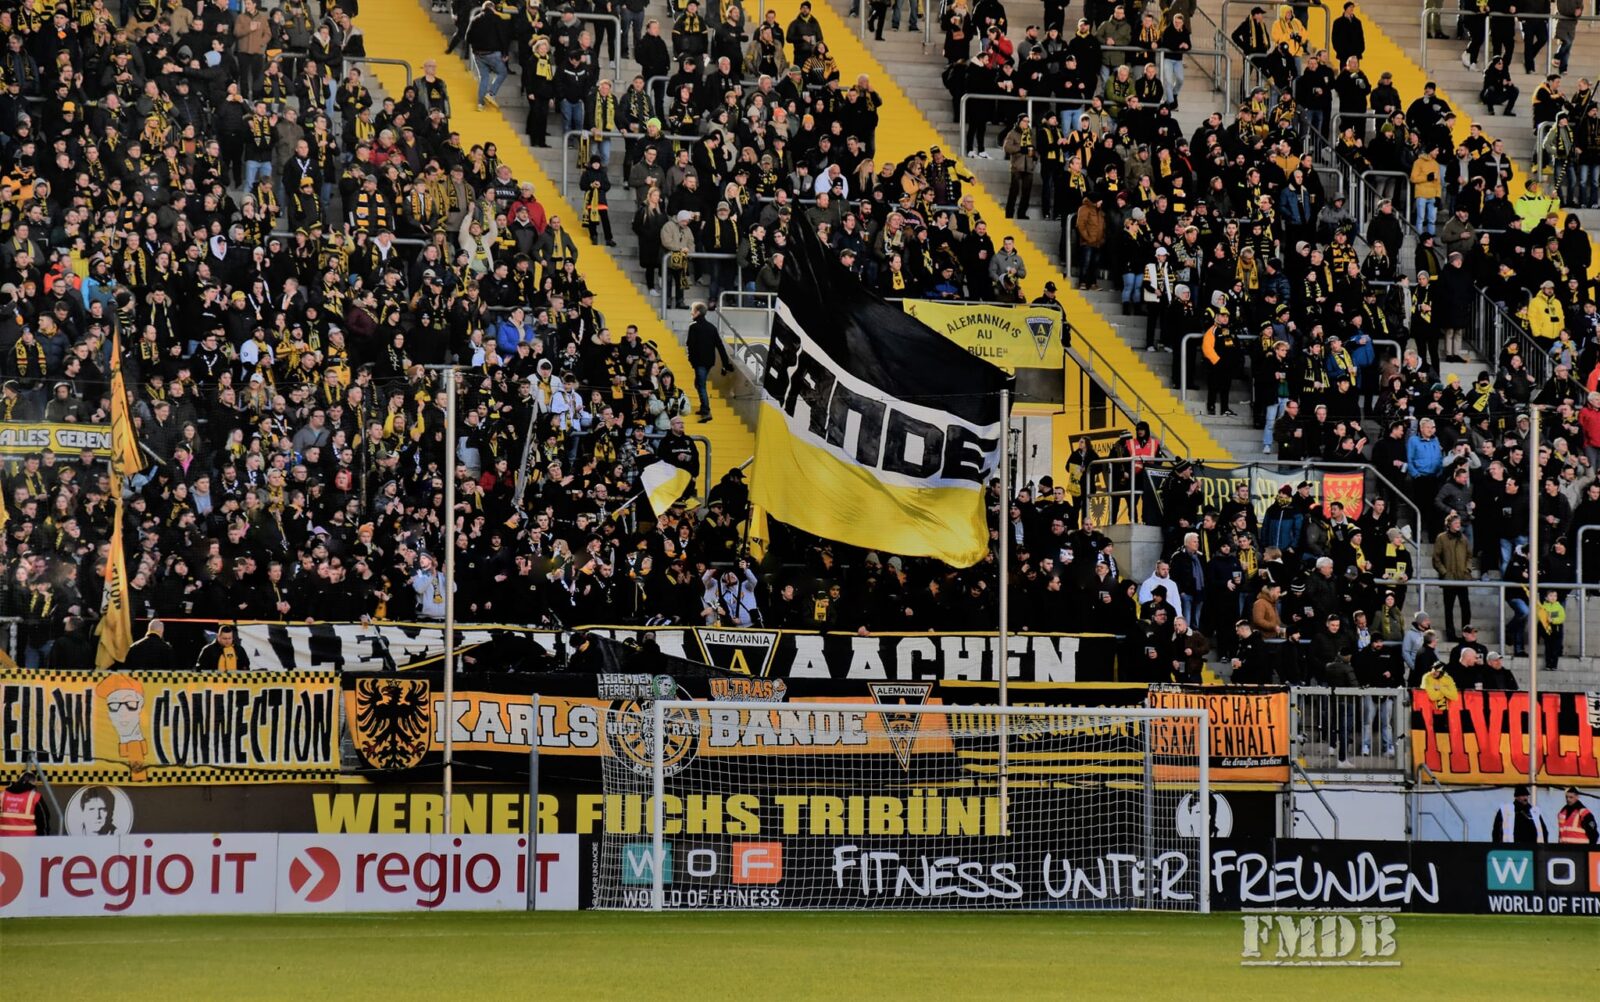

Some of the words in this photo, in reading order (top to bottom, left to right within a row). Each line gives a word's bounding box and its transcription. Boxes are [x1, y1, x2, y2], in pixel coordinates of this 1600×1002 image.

[947, 313, 1021, 338] ALEMANNIA'S
[977, 329, 992, 339] AU
[763, 314, 1000, 485] BANDE
[0, 429, 50, 446] ALLES
[704, 633, 771, 646] ALEMANNIA
[789, 635, 1080, 683] AACHEN
[710, 678, 773, 698] ULTRAS
[877, 687, 926, 695] ALEMANNIA
[154, 689, 333, 764] CONNECTION
[434, 700, 599, 748] KARLS
[709, 709, 868, 747] BANDE
[1412, 690, 1599, 777] TIVOLI
[312, 793, 560, 834] WERNER
[576, 794, 761, 835] FUCHS
[40, 838, 194, 912] regio
[355, 838, 501, 908] regio
[832, 845, 1023, 899] FITNESS
[1043, 850, 1194, 900] UNTER
[1211, 850, 1439, 904] FREUNDEN
[623, 891, 682, 907] WOLD
[688, 890, 708, 907] OF
[713, 890, 780, 907] FITNESS
[1488, 895, 1543, 913] WORLD
[1548, 896, 1568, 913] OF
